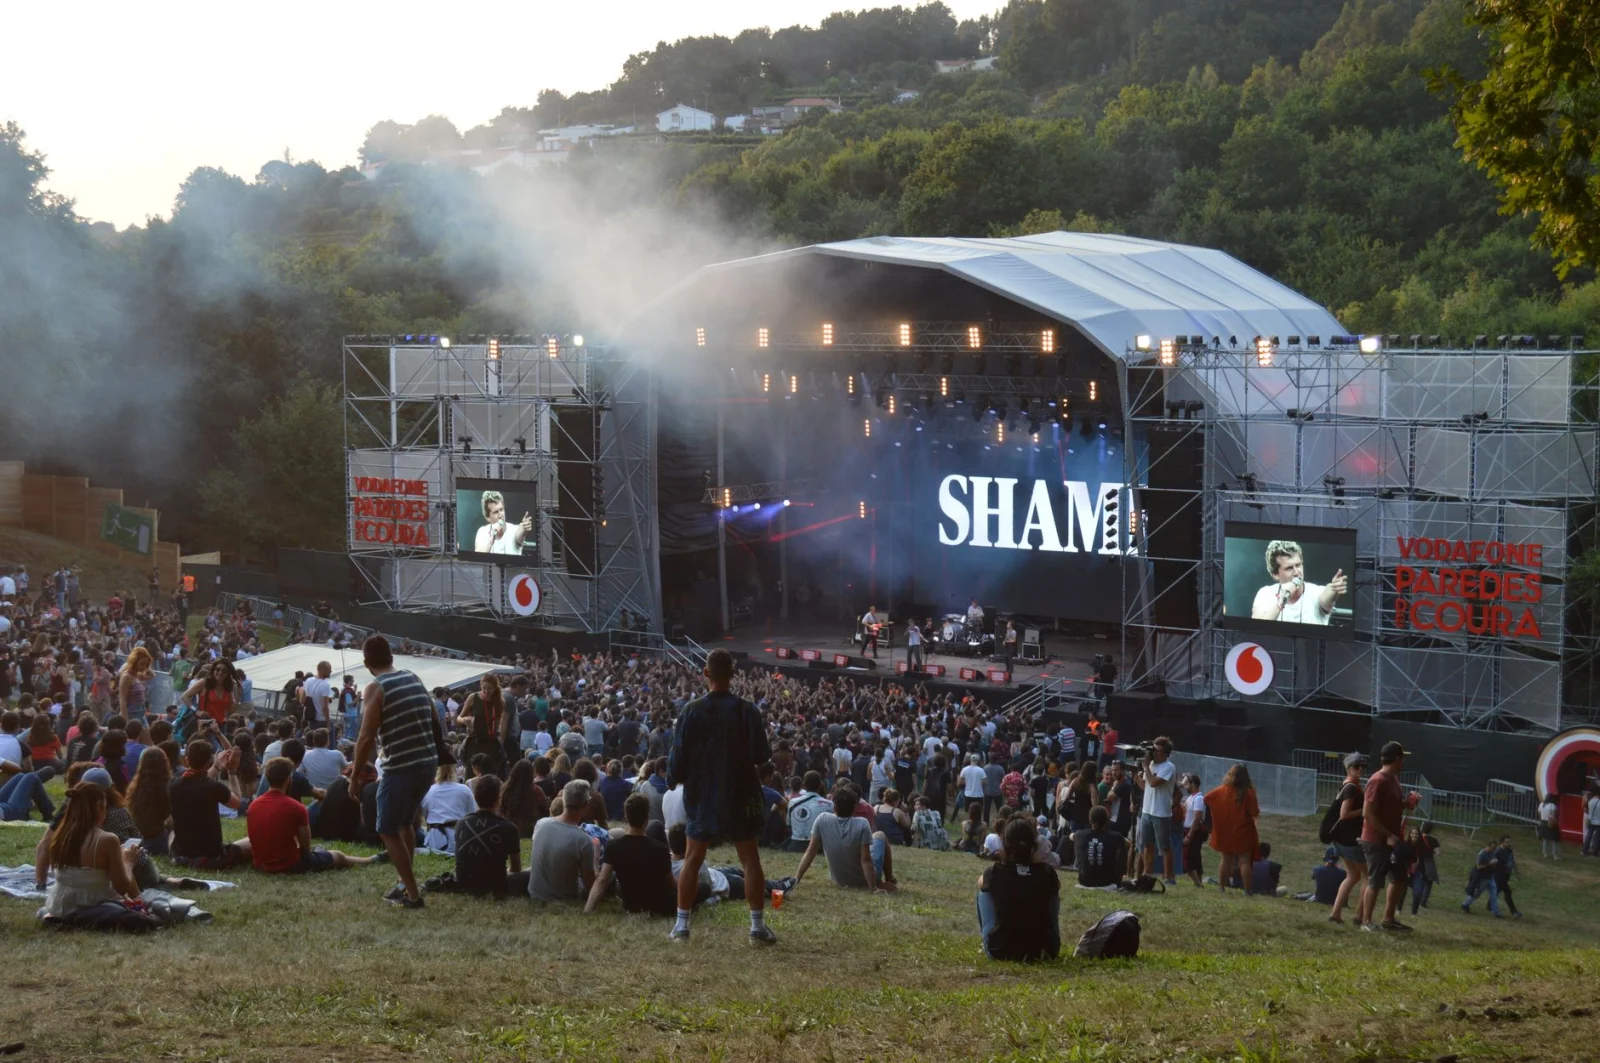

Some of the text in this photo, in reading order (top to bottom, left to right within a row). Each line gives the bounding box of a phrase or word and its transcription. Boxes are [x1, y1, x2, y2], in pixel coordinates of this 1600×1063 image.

[354, 476, 428, 496] VODAFONE
[354, 496, 429, 522] PAREDES
[363, 520, 430, 548] COURA
[1397, 536, 1543, 567] VODAFONE
[1395, 565, 1542, 603] PAREDES
[1410, 599, 1542, 640] COURA
